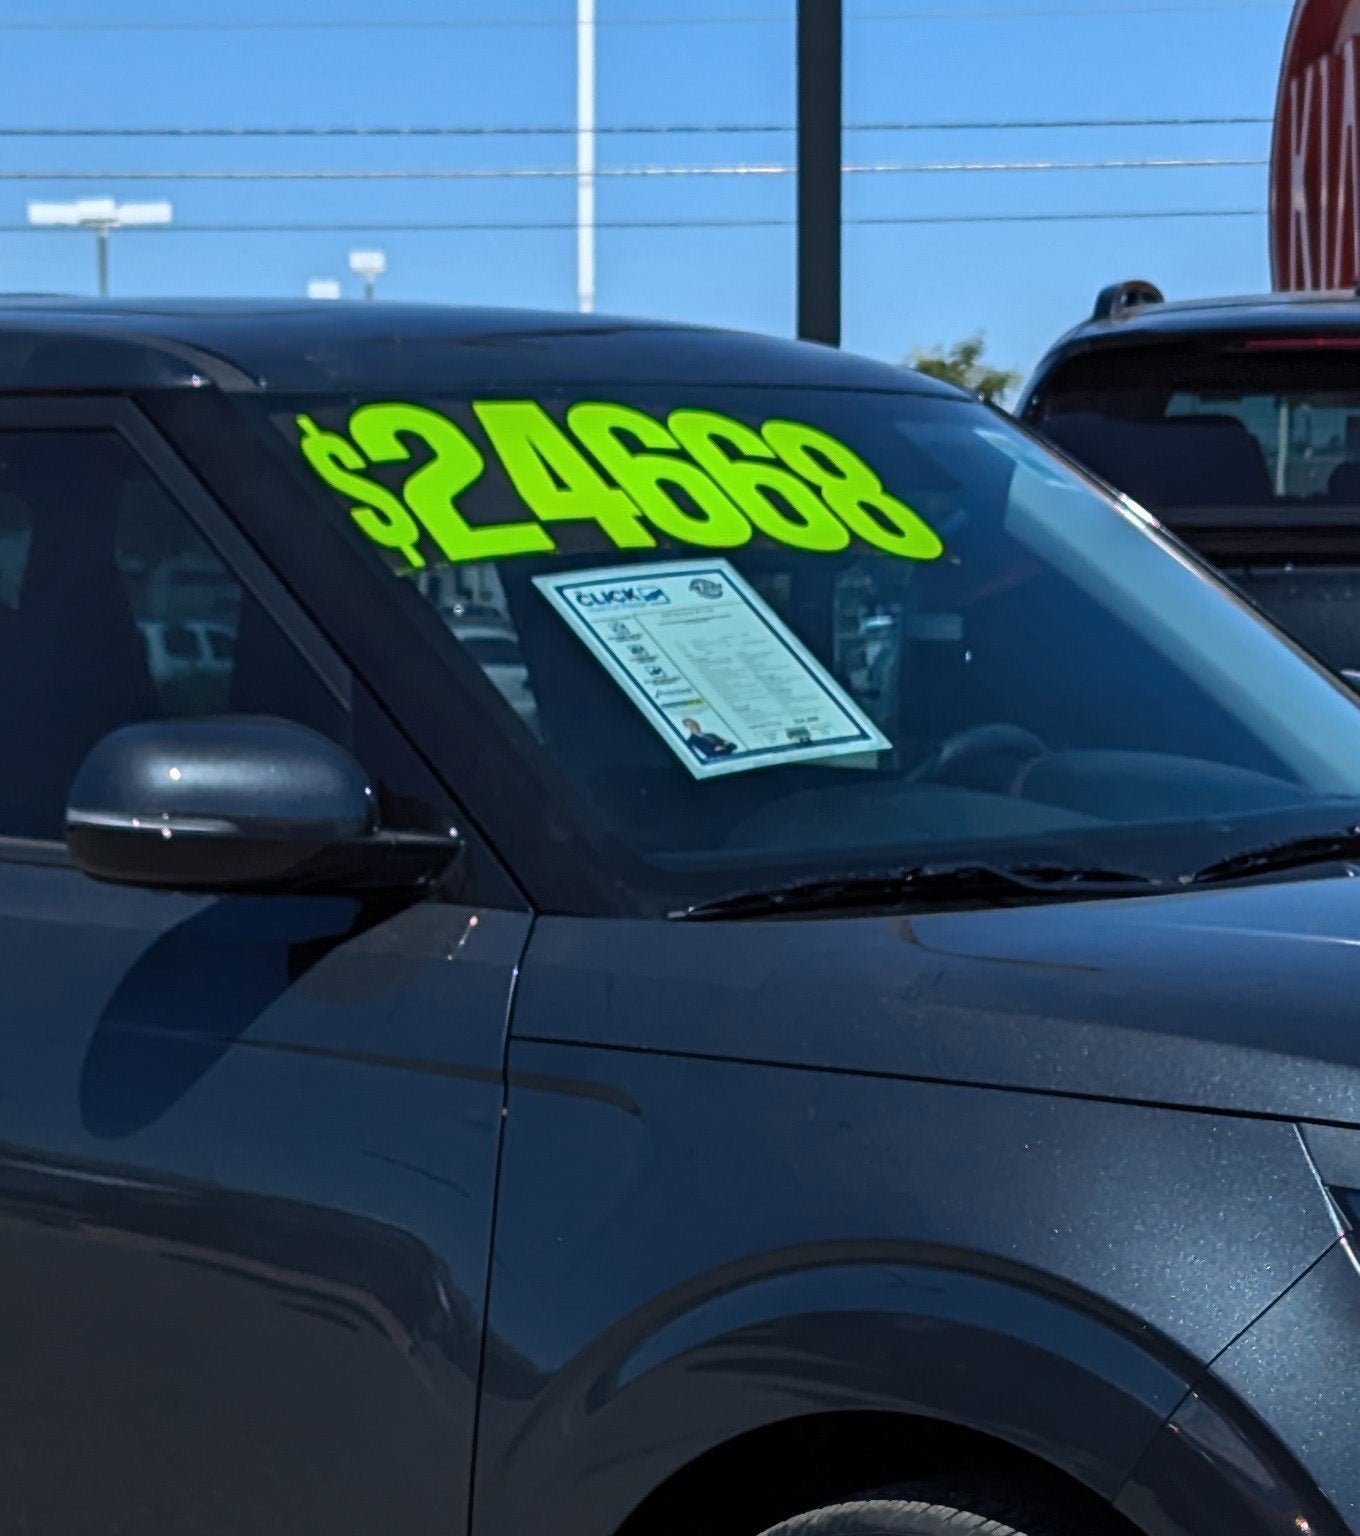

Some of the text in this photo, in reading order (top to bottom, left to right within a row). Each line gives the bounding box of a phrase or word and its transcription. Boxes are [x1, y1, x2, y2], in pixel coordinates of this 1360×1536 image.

[1290, 39, 1360, 291] KIA
[296, 400, 943, 567] $24668
[575, 586, 639, 607] CLICK
